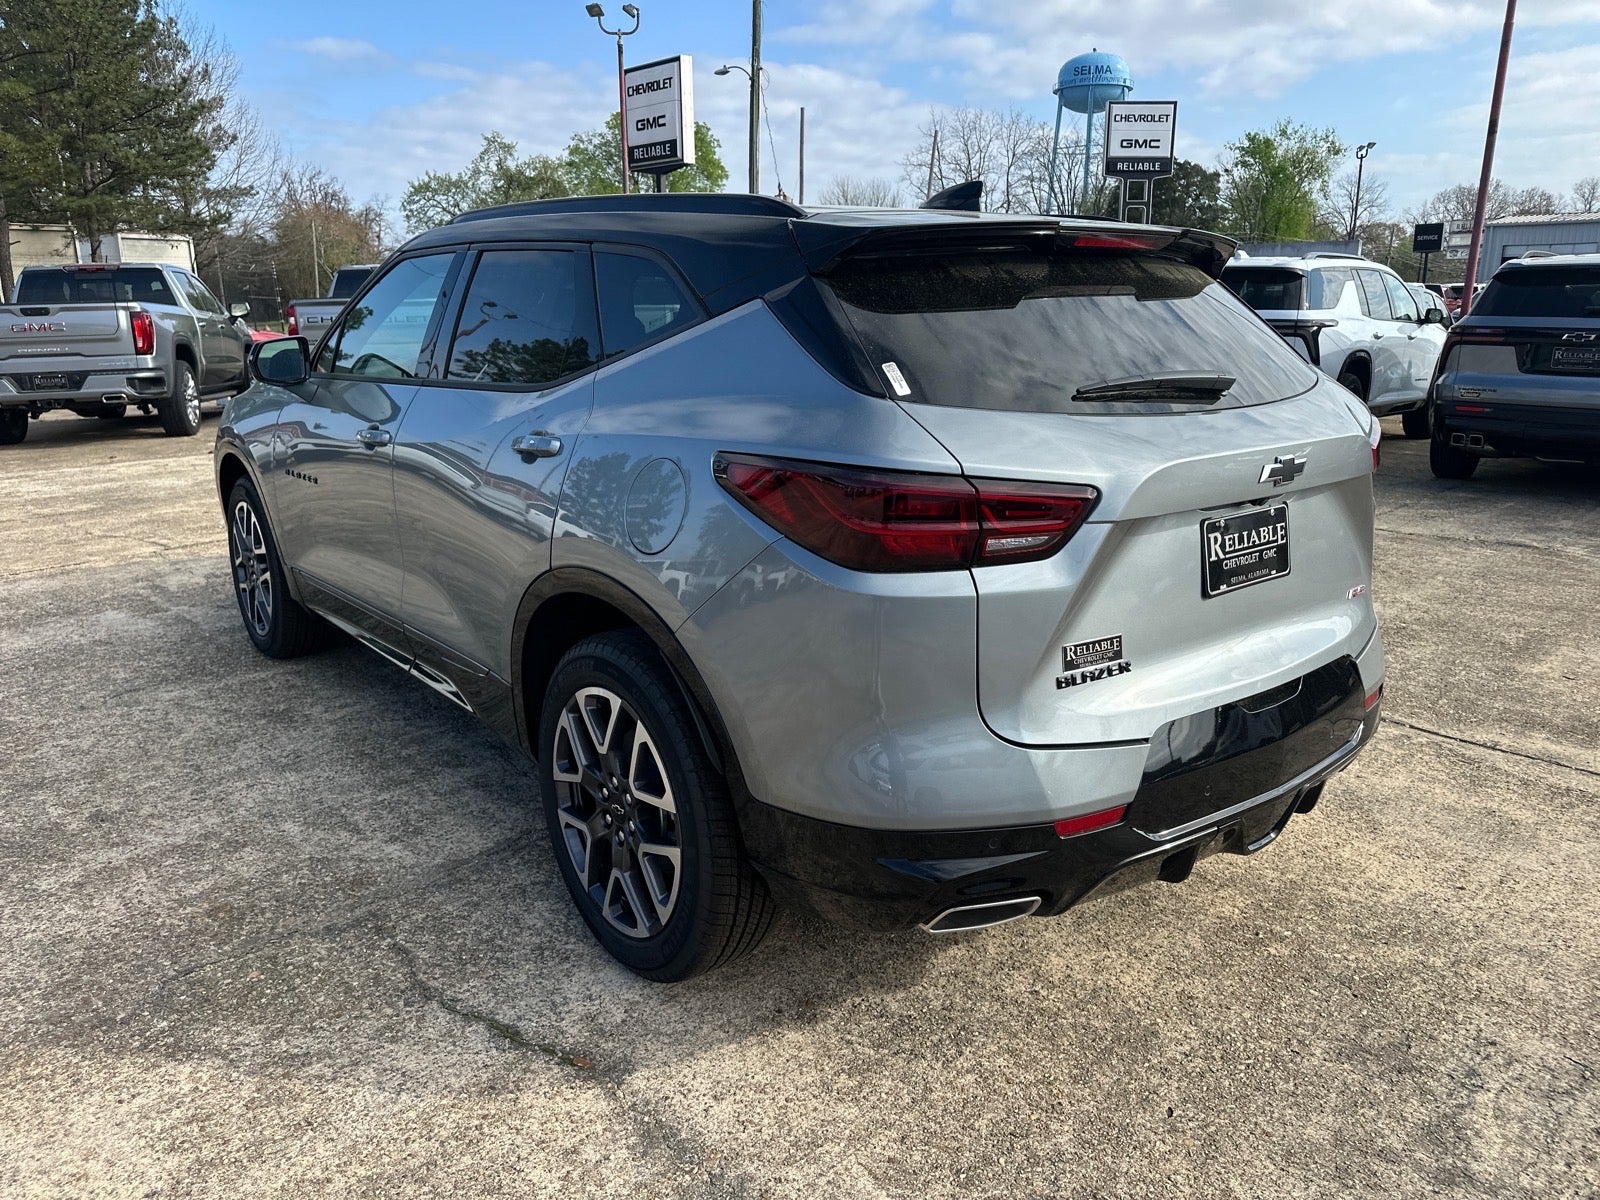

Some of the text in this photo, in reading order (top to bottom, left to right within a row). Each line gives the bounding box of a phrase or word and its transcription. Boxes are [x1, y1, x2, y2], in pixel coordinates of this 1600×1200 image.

[1073, 65, 1112, 77] SELMA
[627, 76, 673, 97] CHEVROLET
[636, 115, 666, 131] GMC
[1114, 113, 1170, 123] CHEVROLET
[634, 143, 671, 160] RELIABLE
[1120, 138, 1160, 149] GMC
[1117, 162, 1161, 171] RELIABLE
[11, 322, 66, 332] GMC
[1208, 522, 1287, 562] RELIABLE
[1222, 548, 1277, 570] CHEVROLET GMC
[1066, 638, 1120, 661] RELIABLE
[1073, 654, 1103, 665] CHEVROLET
[1056, 661, 1132, 690] BLAZER
